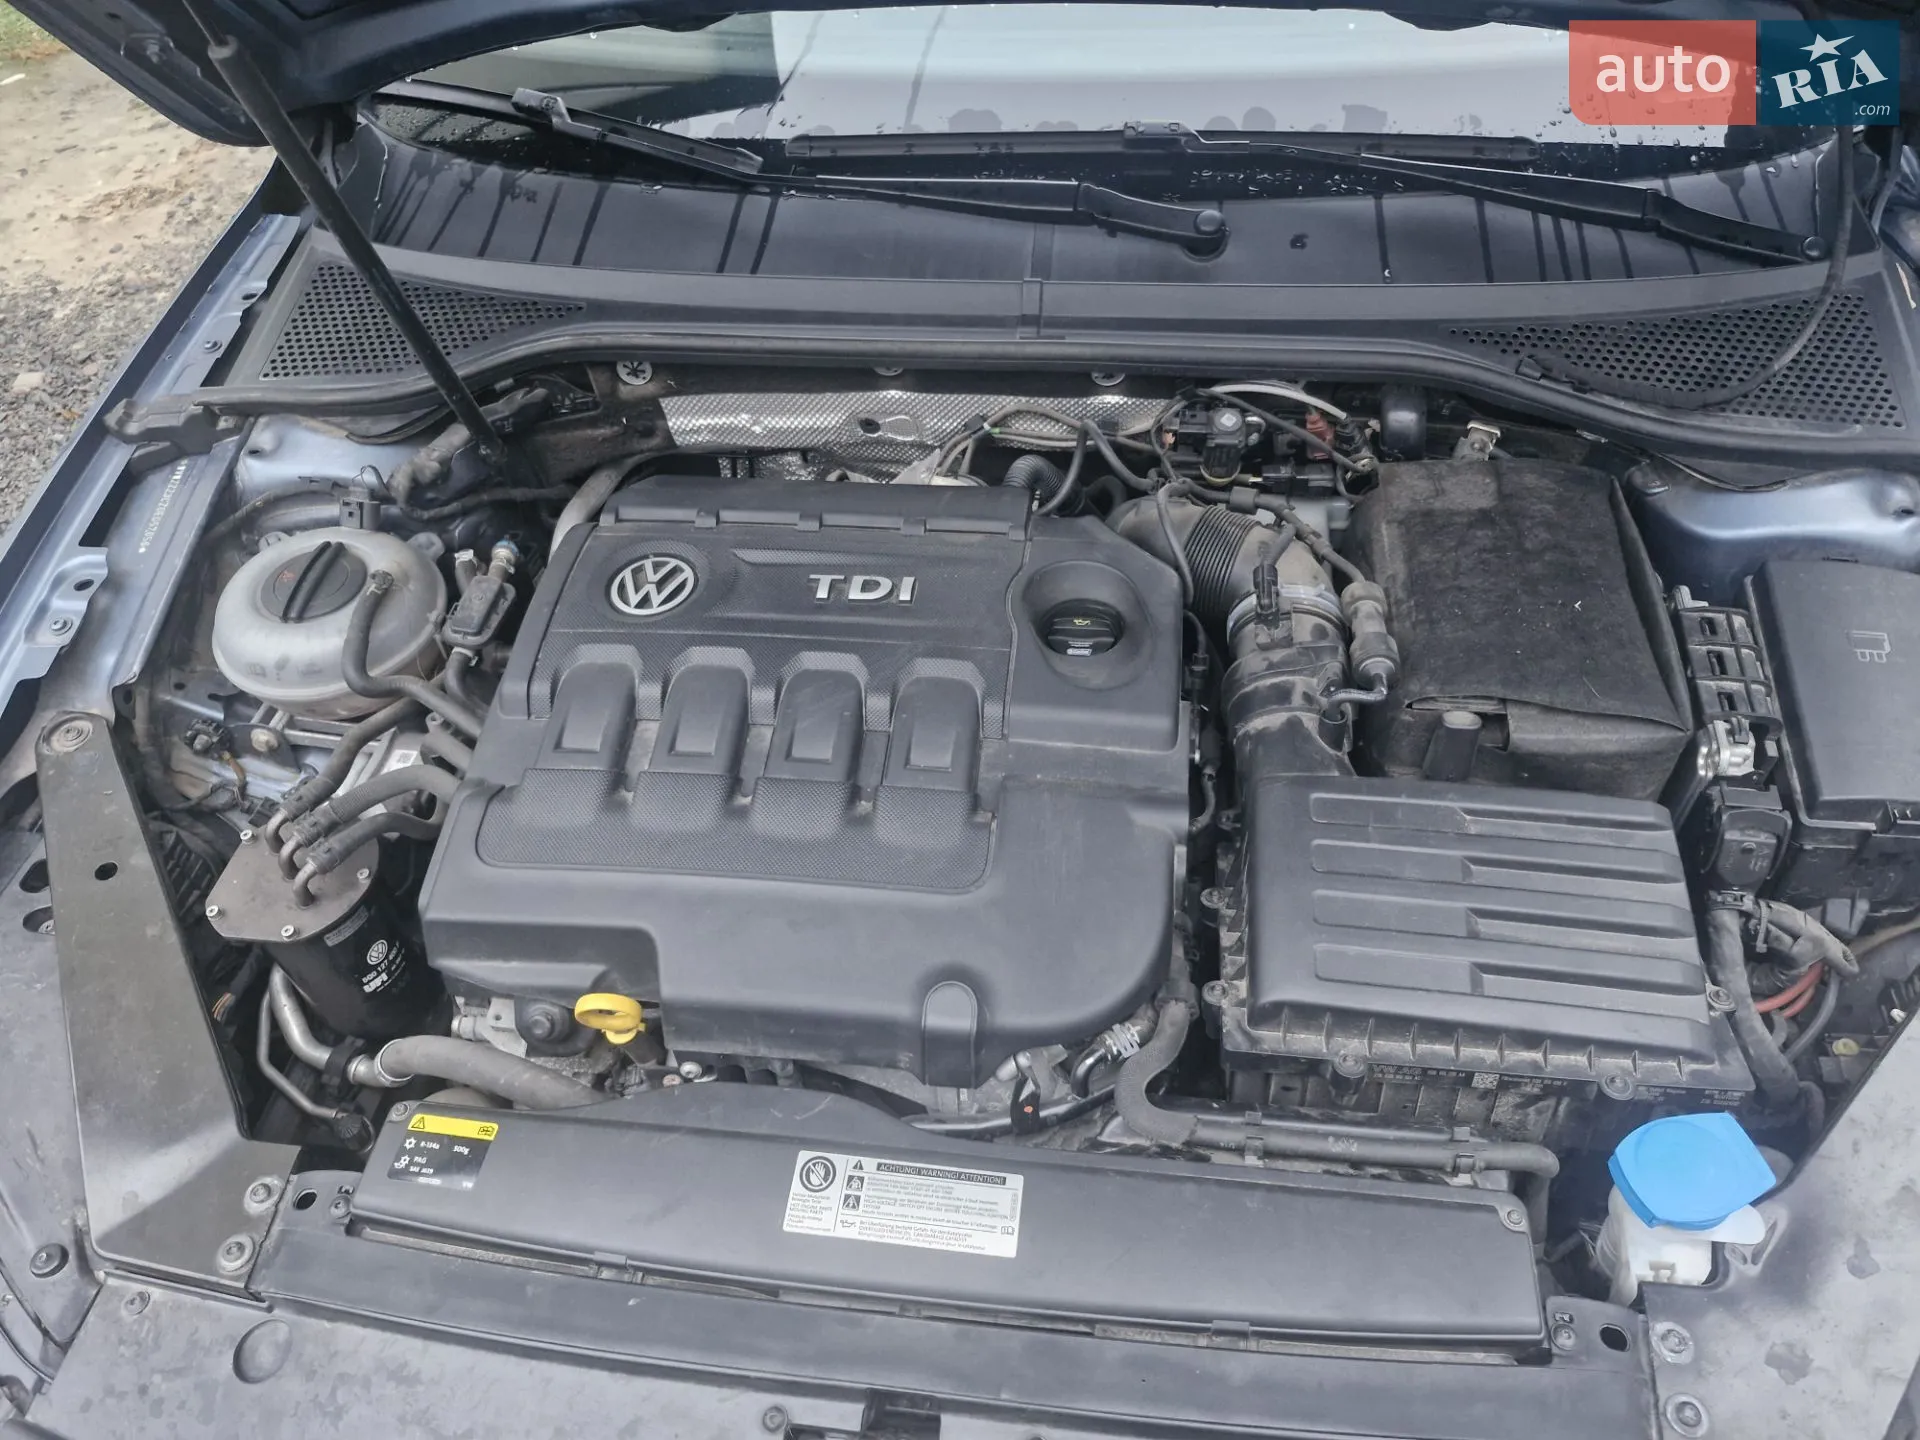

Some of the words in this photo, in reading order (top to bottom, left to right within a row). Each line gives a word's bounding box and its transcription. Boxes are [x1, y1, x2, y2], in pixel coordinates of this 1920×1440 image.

[808, 573, 917, 606] TDI
[879, 1164, 919, 1175] ACHTUNG!
[920, 1168, 959, 1180] WARNING!
[960, 1173, 1004, 1185] ATTENTION!
